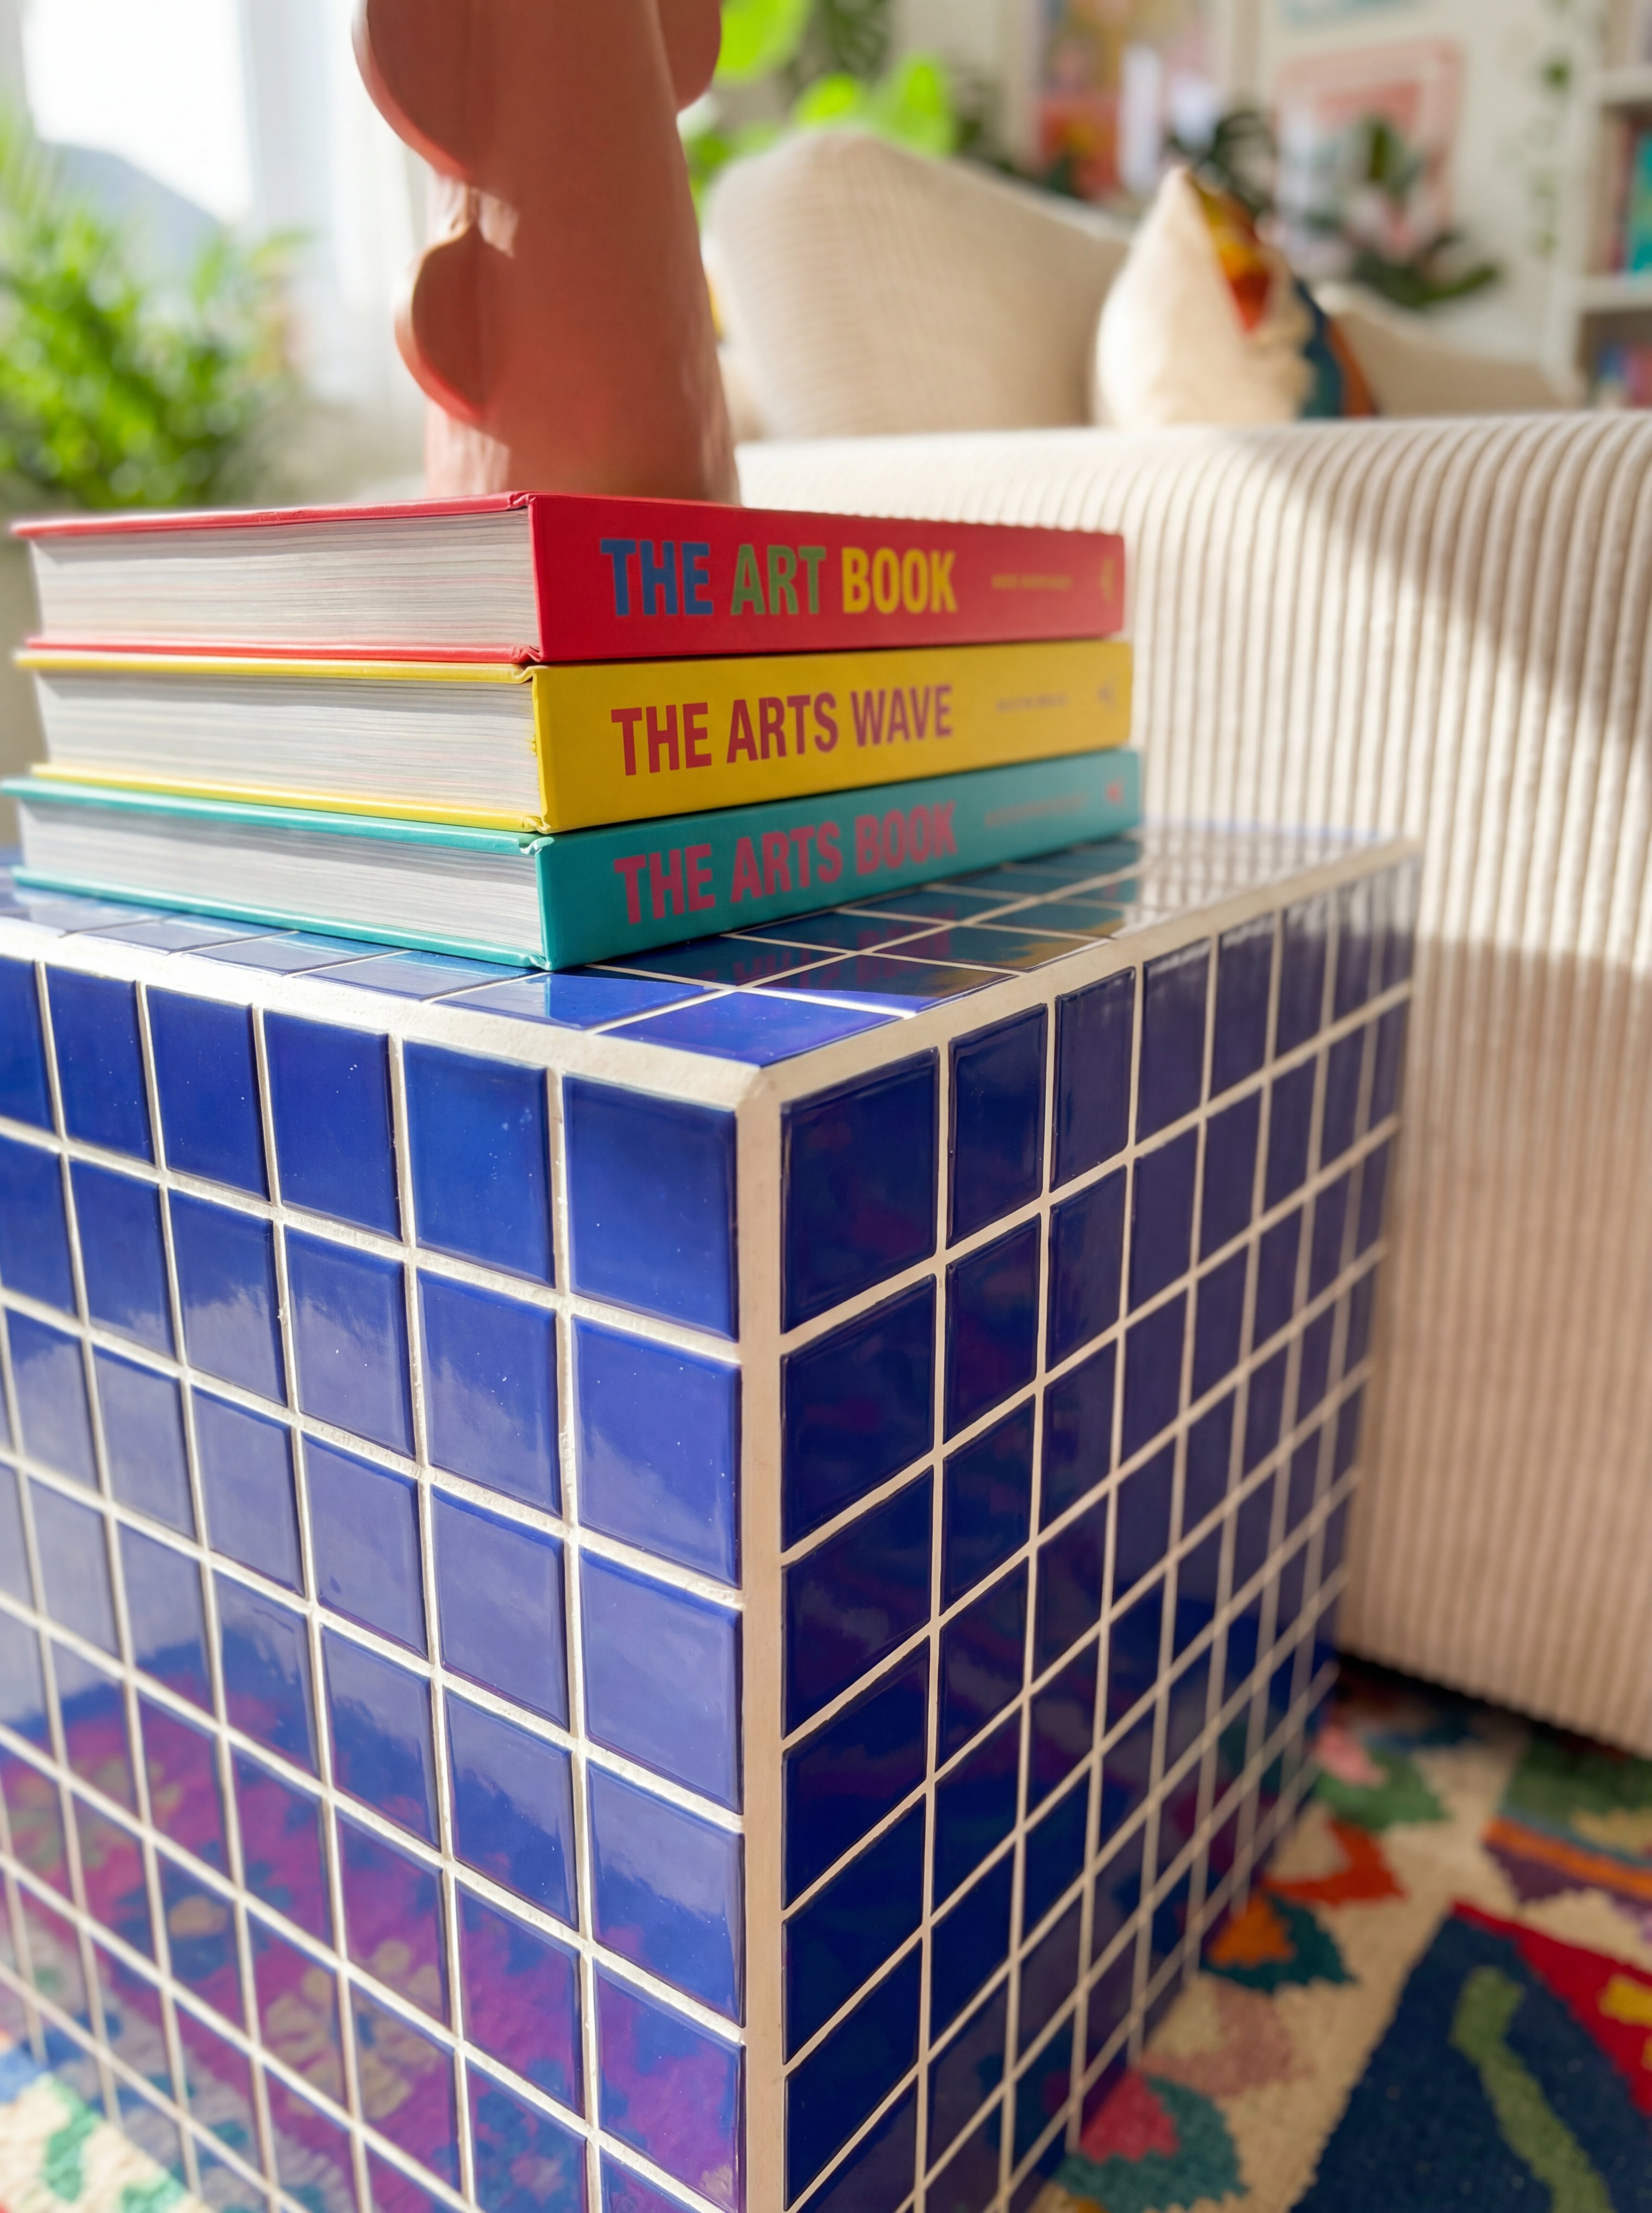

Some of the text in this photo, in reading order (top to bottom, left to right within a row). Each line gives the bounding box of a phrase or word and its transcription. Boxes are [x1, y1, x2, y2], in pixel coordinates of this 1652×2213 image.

[600, 538, 958, 616] THE ART BOOK
[611, 684, 953, 776] THE ARTS WAVE
[614, 844, 716, 924] THE
[731, 821, 843, 904] ARTS
[854, 801, 957, 876] BOOK
